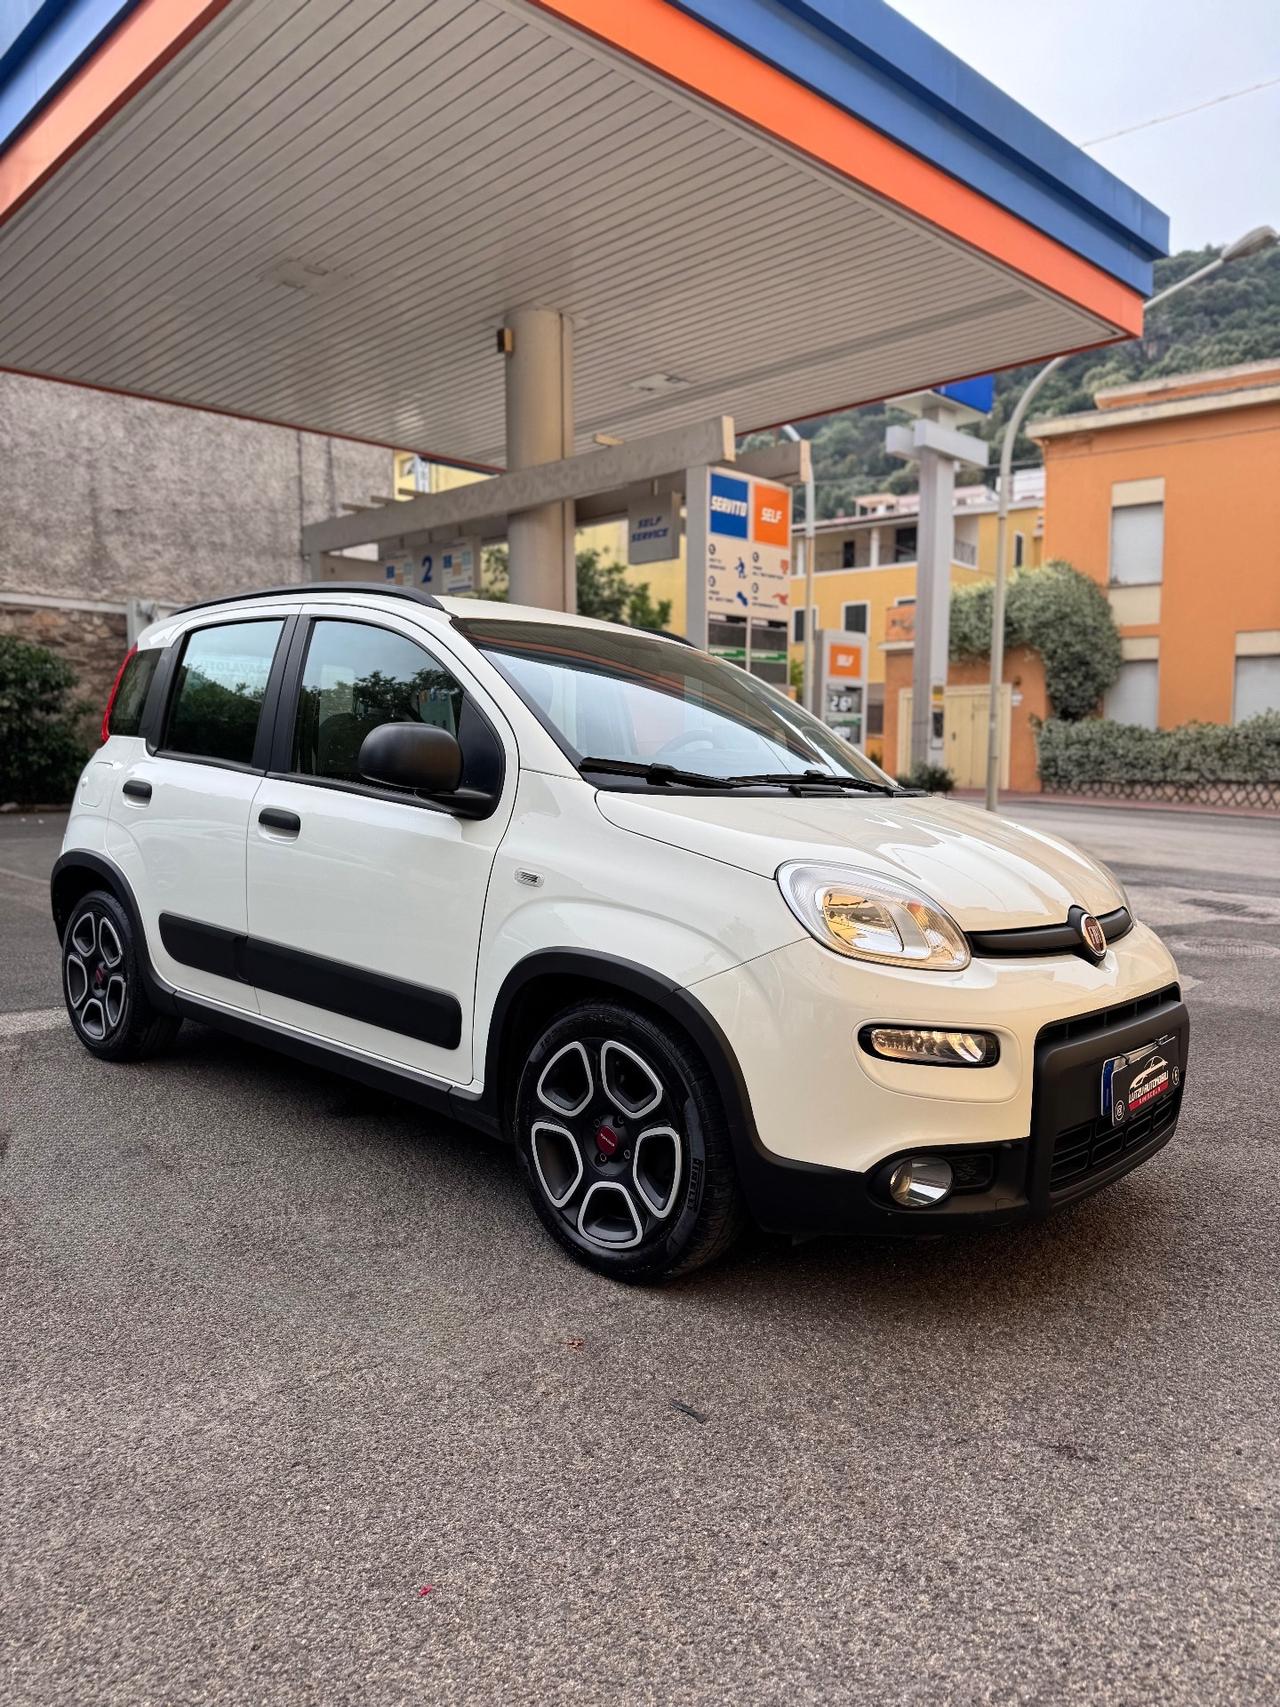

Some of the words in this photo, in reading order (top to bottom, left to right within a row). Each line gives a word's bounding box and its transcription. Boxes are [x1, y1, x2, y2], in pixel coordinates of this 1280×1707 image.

[711, 496, 748, 517] SERVITO
[638, 515, 663, 528] SELF
[761, 507, 783, 524] SELF
[631, 527, 669, 542] SERVICE
[421, 555, 433, 583] 2
